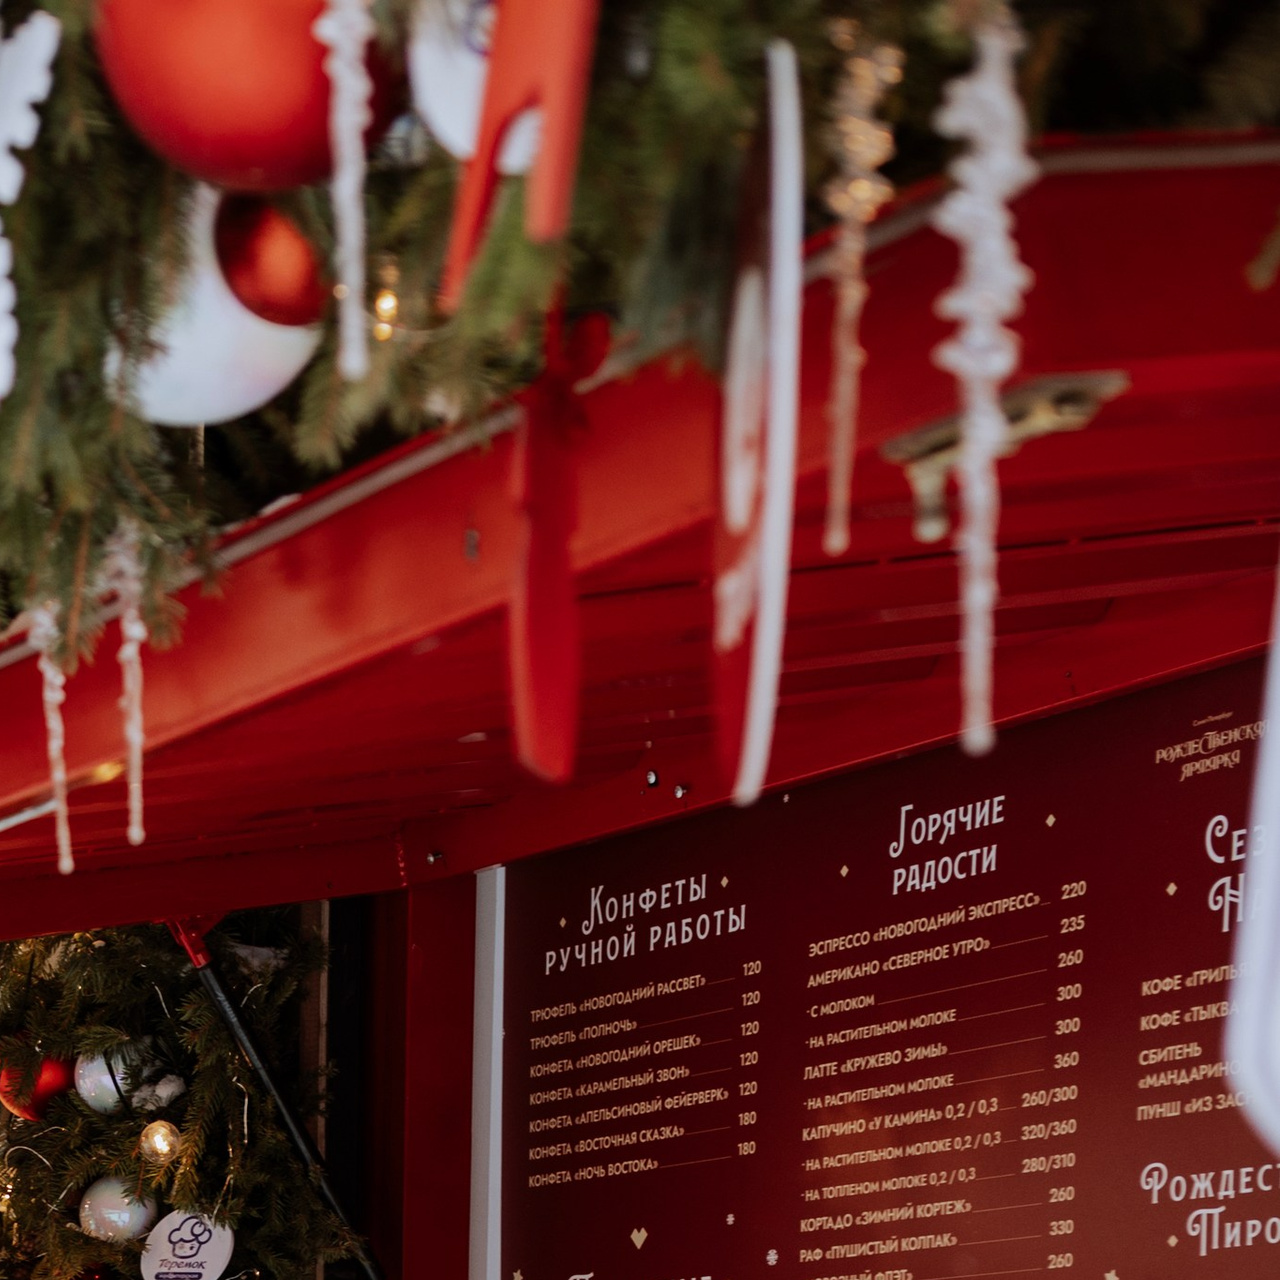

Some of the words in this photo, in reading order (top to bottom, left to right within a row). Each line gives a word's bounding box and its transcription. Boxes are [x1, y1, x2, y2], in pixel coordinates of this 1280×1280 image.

[892, 844, 998, 895] РАДОСТИ
[1062, 881, 1086, 899] 220
[1061, 915, 1085, 933] 235
[545, 924, 635, 975] РУЧНОЙ
[650, 905, 746, 951] РАБОТЫ
[743, 961, 761, 975] 120
[742, 991, 760, 1005] 120
[741, 1021, 759, 1035] 120
[1056, 1018, 1080, 1035] 300
[740, 1051, 758, 1066] 120
[1139, 1044, 1202, 1065] СБИТЕНЬ
[739, 1081, 757, 1095] 120
[1022, 1085, 1078, 1107] 260/300
[739, 1111, 756, 1125] 180
[738, 1141, 756, 1155] 180
[1049, 1186, 1074, 1202] 260
[1050, 1220, 1074, 1235] 330
[1048, 1253, 1073, 1269] 260
